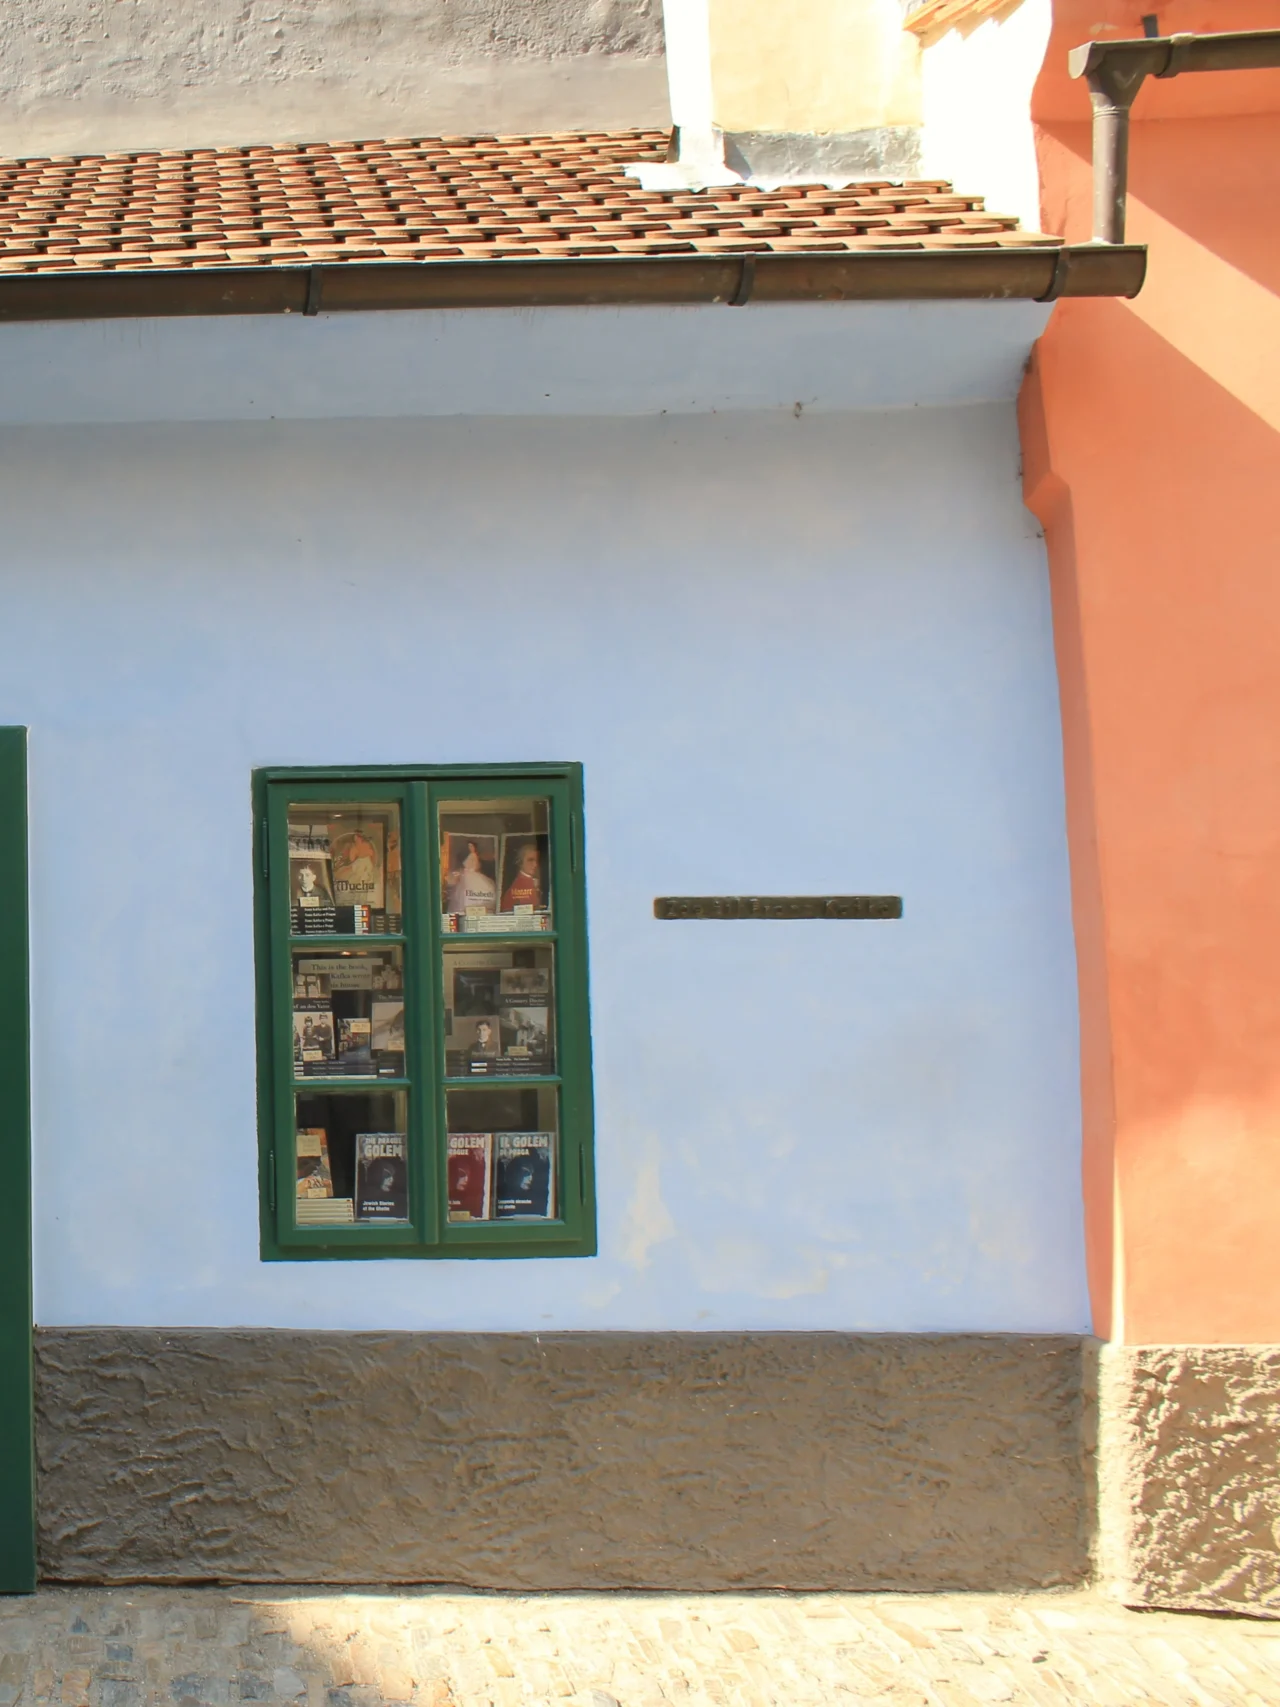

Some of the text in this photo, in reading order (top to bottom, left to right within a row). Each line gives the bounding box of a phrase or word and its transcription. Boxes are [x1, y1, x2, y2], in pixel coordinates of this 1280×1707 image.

[336, 879, 375, 892] Mucha
[466, 889, 495, 898] Elisabeth
[450, 1137, 485, 1148] GOLEM
[499, 1136, 548, 1148] IL GOLEM
[364, 1144, 403, 1157] GOLEM
